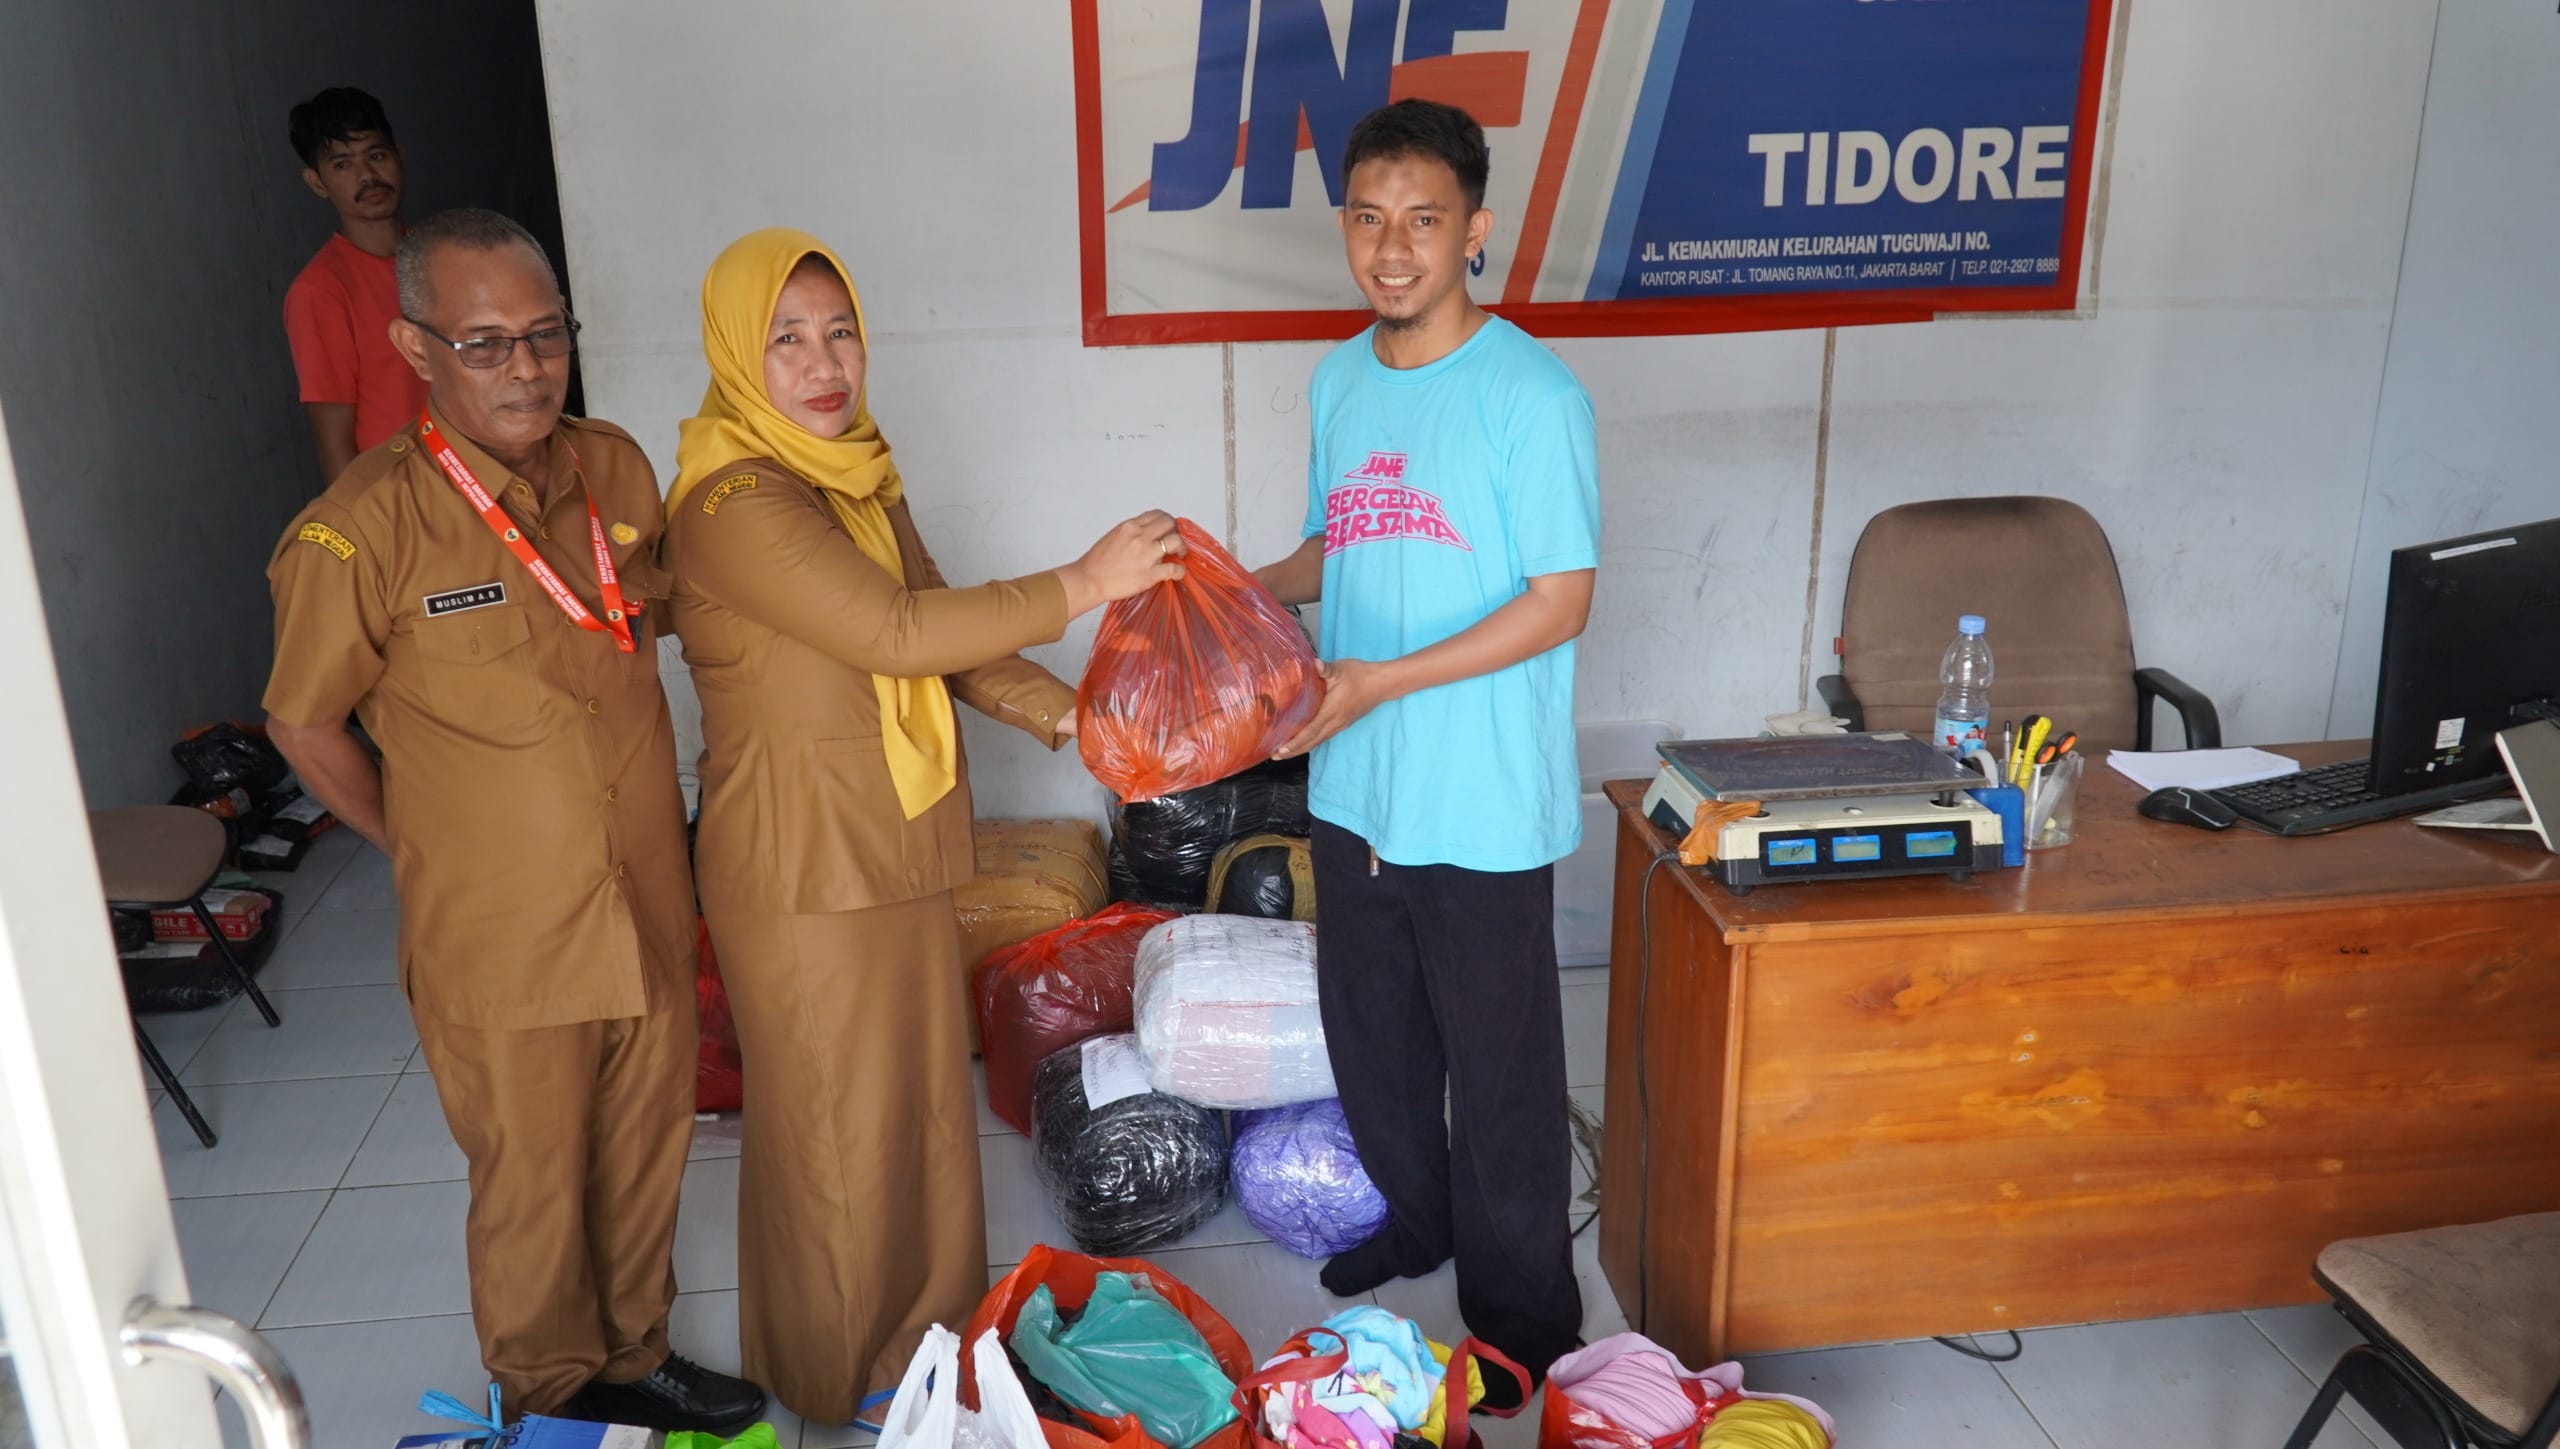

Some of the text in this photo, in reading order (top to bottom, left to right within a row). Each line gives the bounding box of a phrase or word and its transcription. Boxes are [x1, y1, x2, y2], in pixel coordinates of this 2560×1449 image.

[1148, 0, 1529, 212] JNE
[1748, 125, 2070, 207] TIDORE
[1641, 231, 1990, 262] JL. KEMAKMURAN KELURAHAN TUGUWAJI NO.
[1641, 271, 1686, 287] KANTOR
[1688, 269, 1724, 285] PUSAT
[1731, 269, 1746, 284] JL.
[1749, 267, 1794, 282] TOMANG
[1796, 265, 1825, 281] RAYA
[1860, 262, 1908, 278] JAKARTA
[1909, 261, 1945, 276] BARAT
[1990, 259, 2034, 275] 021-2927
[2036, 257, 2060, 273] 8888
[1361, 456, 1404, 478] JNE
[1326, 487, 1442, 520] BERGERAK
[1324, 511, 1461, 552] BERSAMA
[435, 594, 475, 609] MUSLIM
